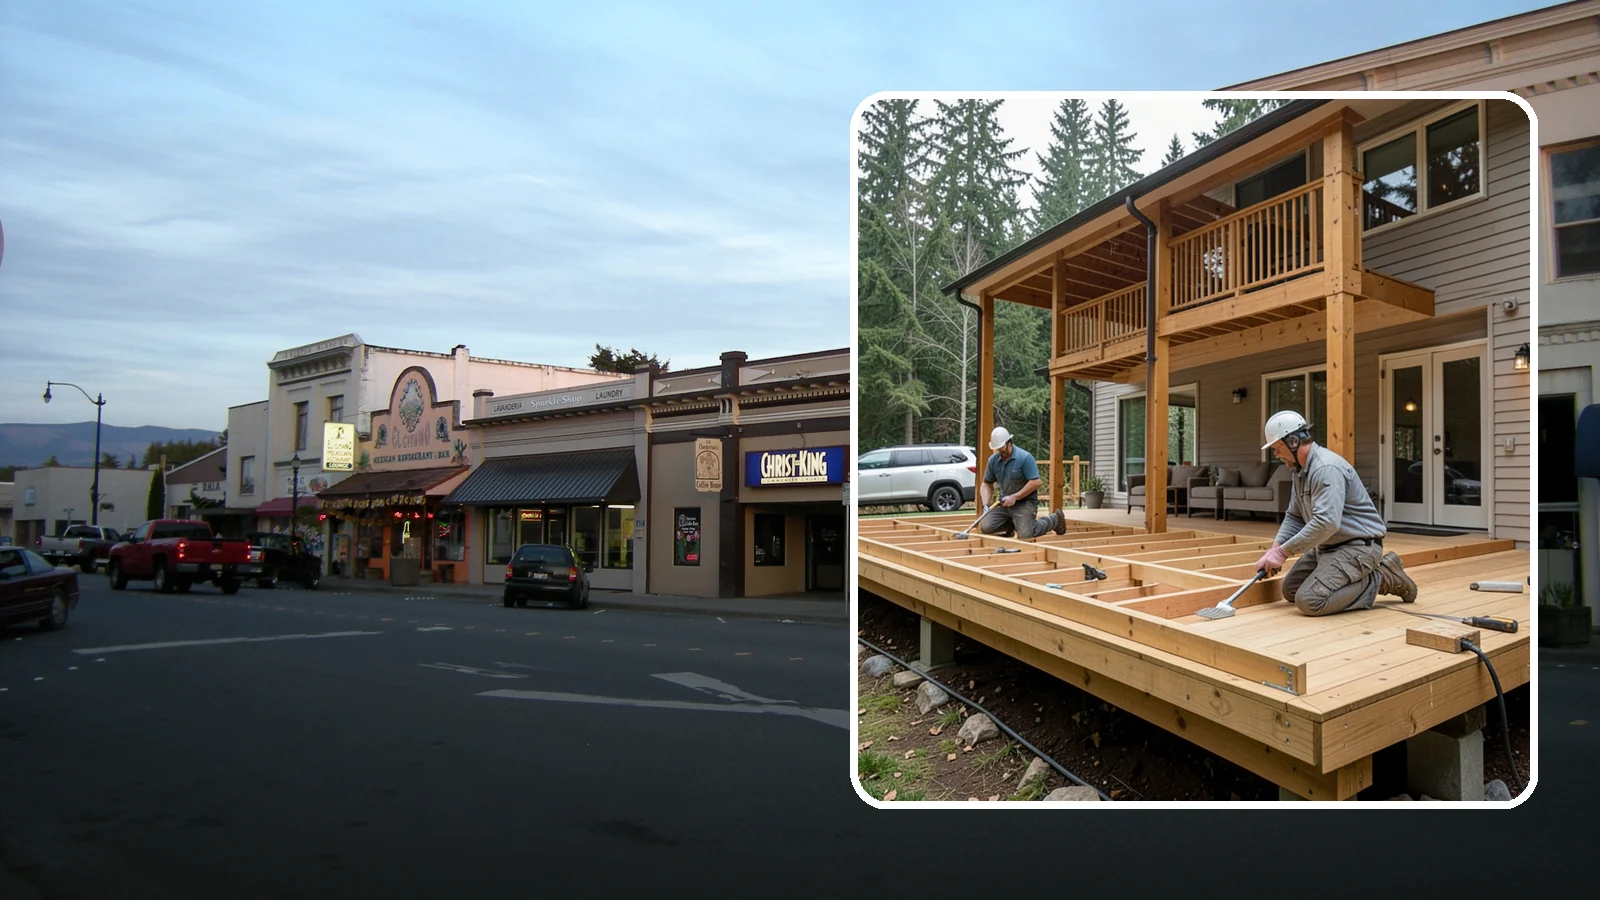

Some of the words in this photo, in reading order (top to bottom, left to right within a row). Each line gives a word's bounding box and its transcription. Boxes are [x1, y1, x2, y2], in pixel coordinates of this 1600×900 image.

[493, 402, 522, 413] LAVANDERIA
[531, 399, 560, 409] Sparkle
[562, 394, 583, 406] Shop
[595, 389, 624, 400] LAUNDRY
[373, 455, 396, 464] MEXICAN
[398, 451, 433, 463] RESTAURANT
[438, 450, 450, 459] BAR
[761, 452, 796, 478] CHRIST
[799, 450, 828, 476] KING
[696, 480, 709, 489] Coffee
[710, 480, 722, 489] House
